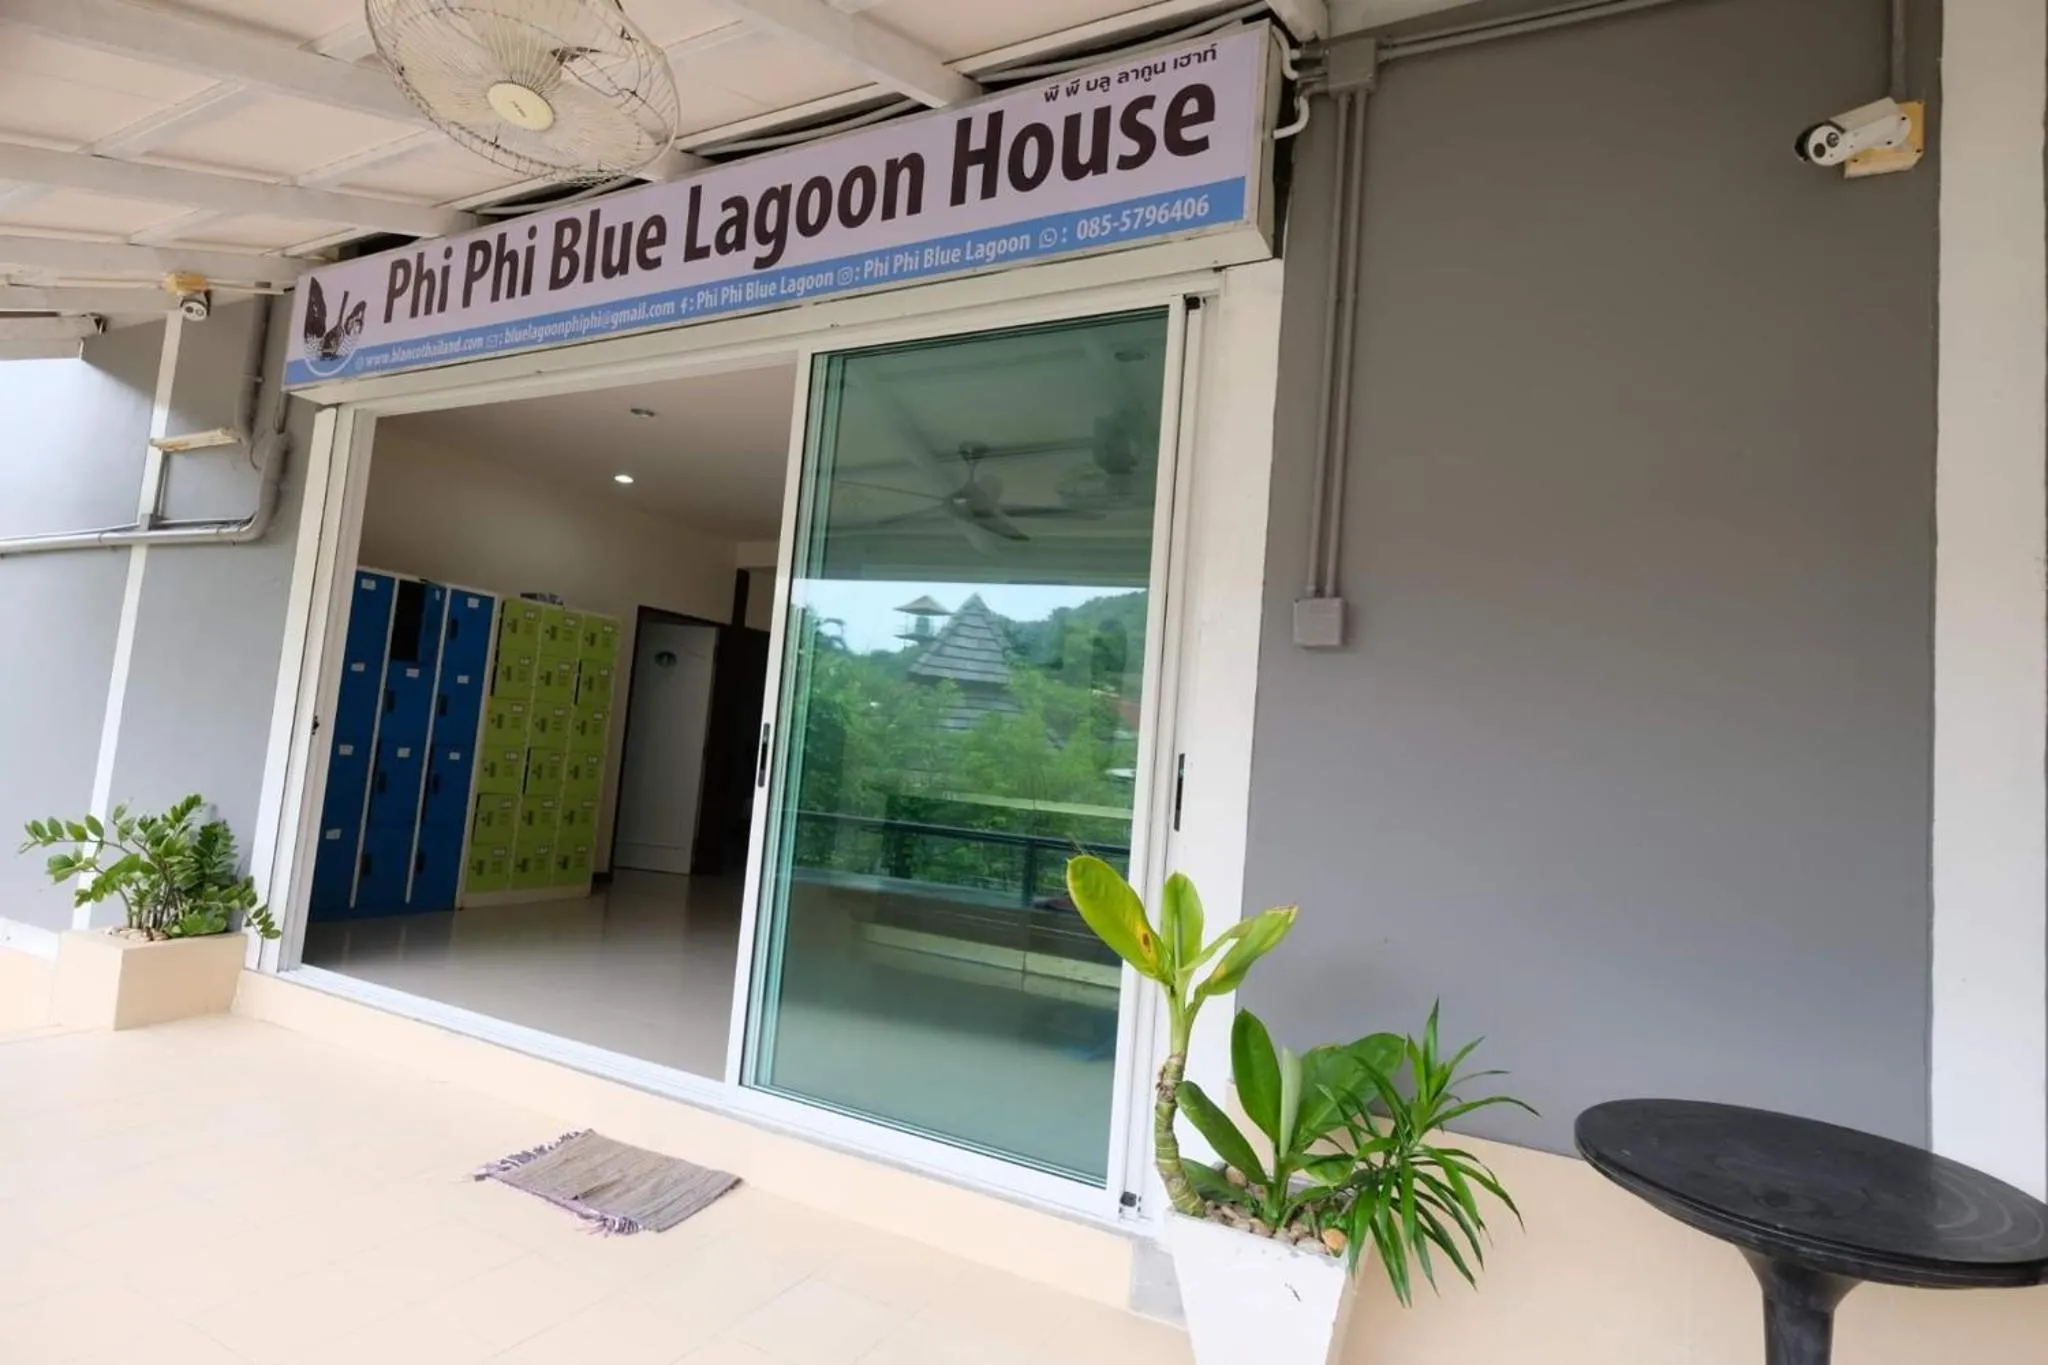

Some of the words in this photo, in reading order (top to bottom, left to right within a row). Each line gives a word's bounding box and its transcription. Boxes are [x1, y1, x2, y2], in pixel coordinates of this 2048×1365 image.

[1086, 76, 1111, 93] บลู
[1118, 61, 1167, 84] ลากูน
[383, 246, 453, 324] Phi
[461, 225, 538, 308] Phi
[548, 208, 667, 291] Blue
[683, 152, 925, 270] Lagoon
[950, 82, 1216, 207] House
[697, 286, 719, 310] Phi
[720, 284, 743, 305] Phi
[745, 279, 777, 300] Blue
[780, 271, 834, 296] Lagoon
[863, 256, 889, 280] Phi
[892, 250, 920, 274] Phi
[923, 245, 961, 268] Blue
[965, 234, 1031, 262] Lagoon
[1076, 193, 1210, 241] 085-5796406
